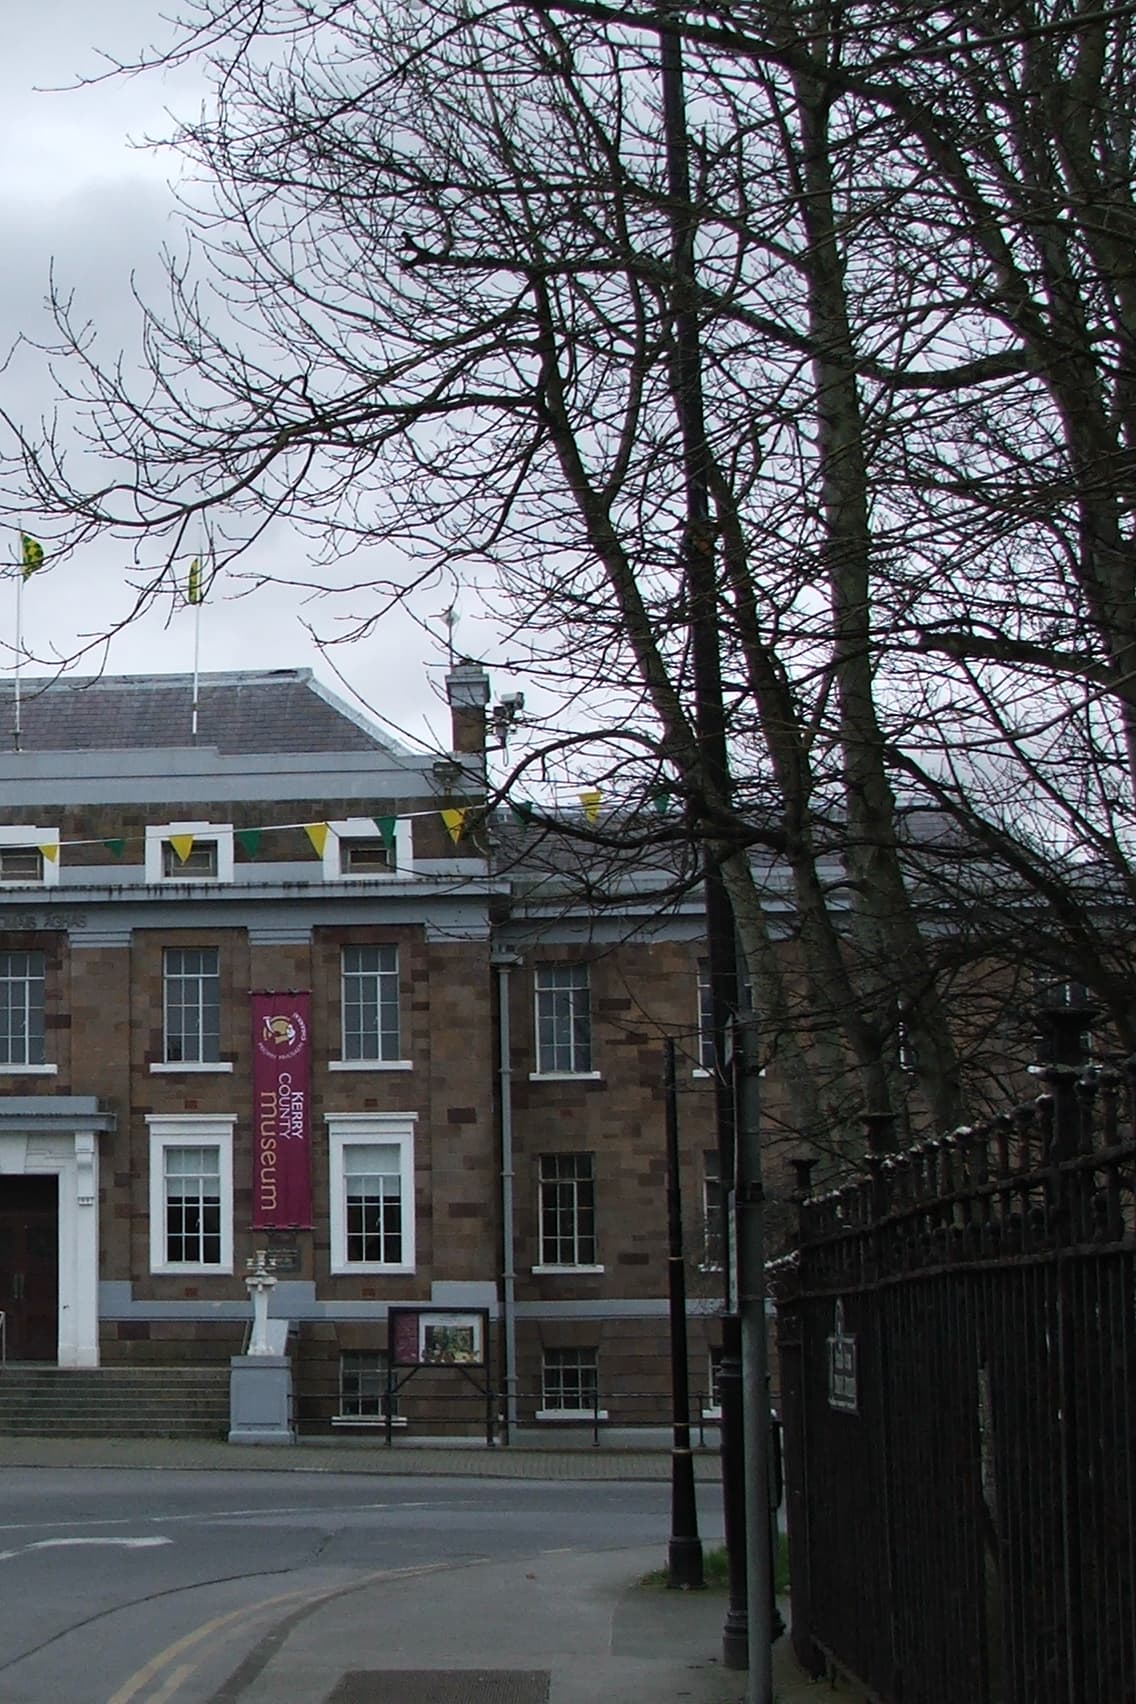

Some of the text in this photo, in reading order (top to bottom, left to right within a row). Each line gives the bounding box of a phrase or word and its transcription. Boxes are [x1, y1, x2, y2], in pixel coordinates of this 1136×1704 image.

[279, 1072, 292, 1140] COUNTY
[291, 1091, 304, 1140] KERRY
[261, 1091, 277, 1210] museum
